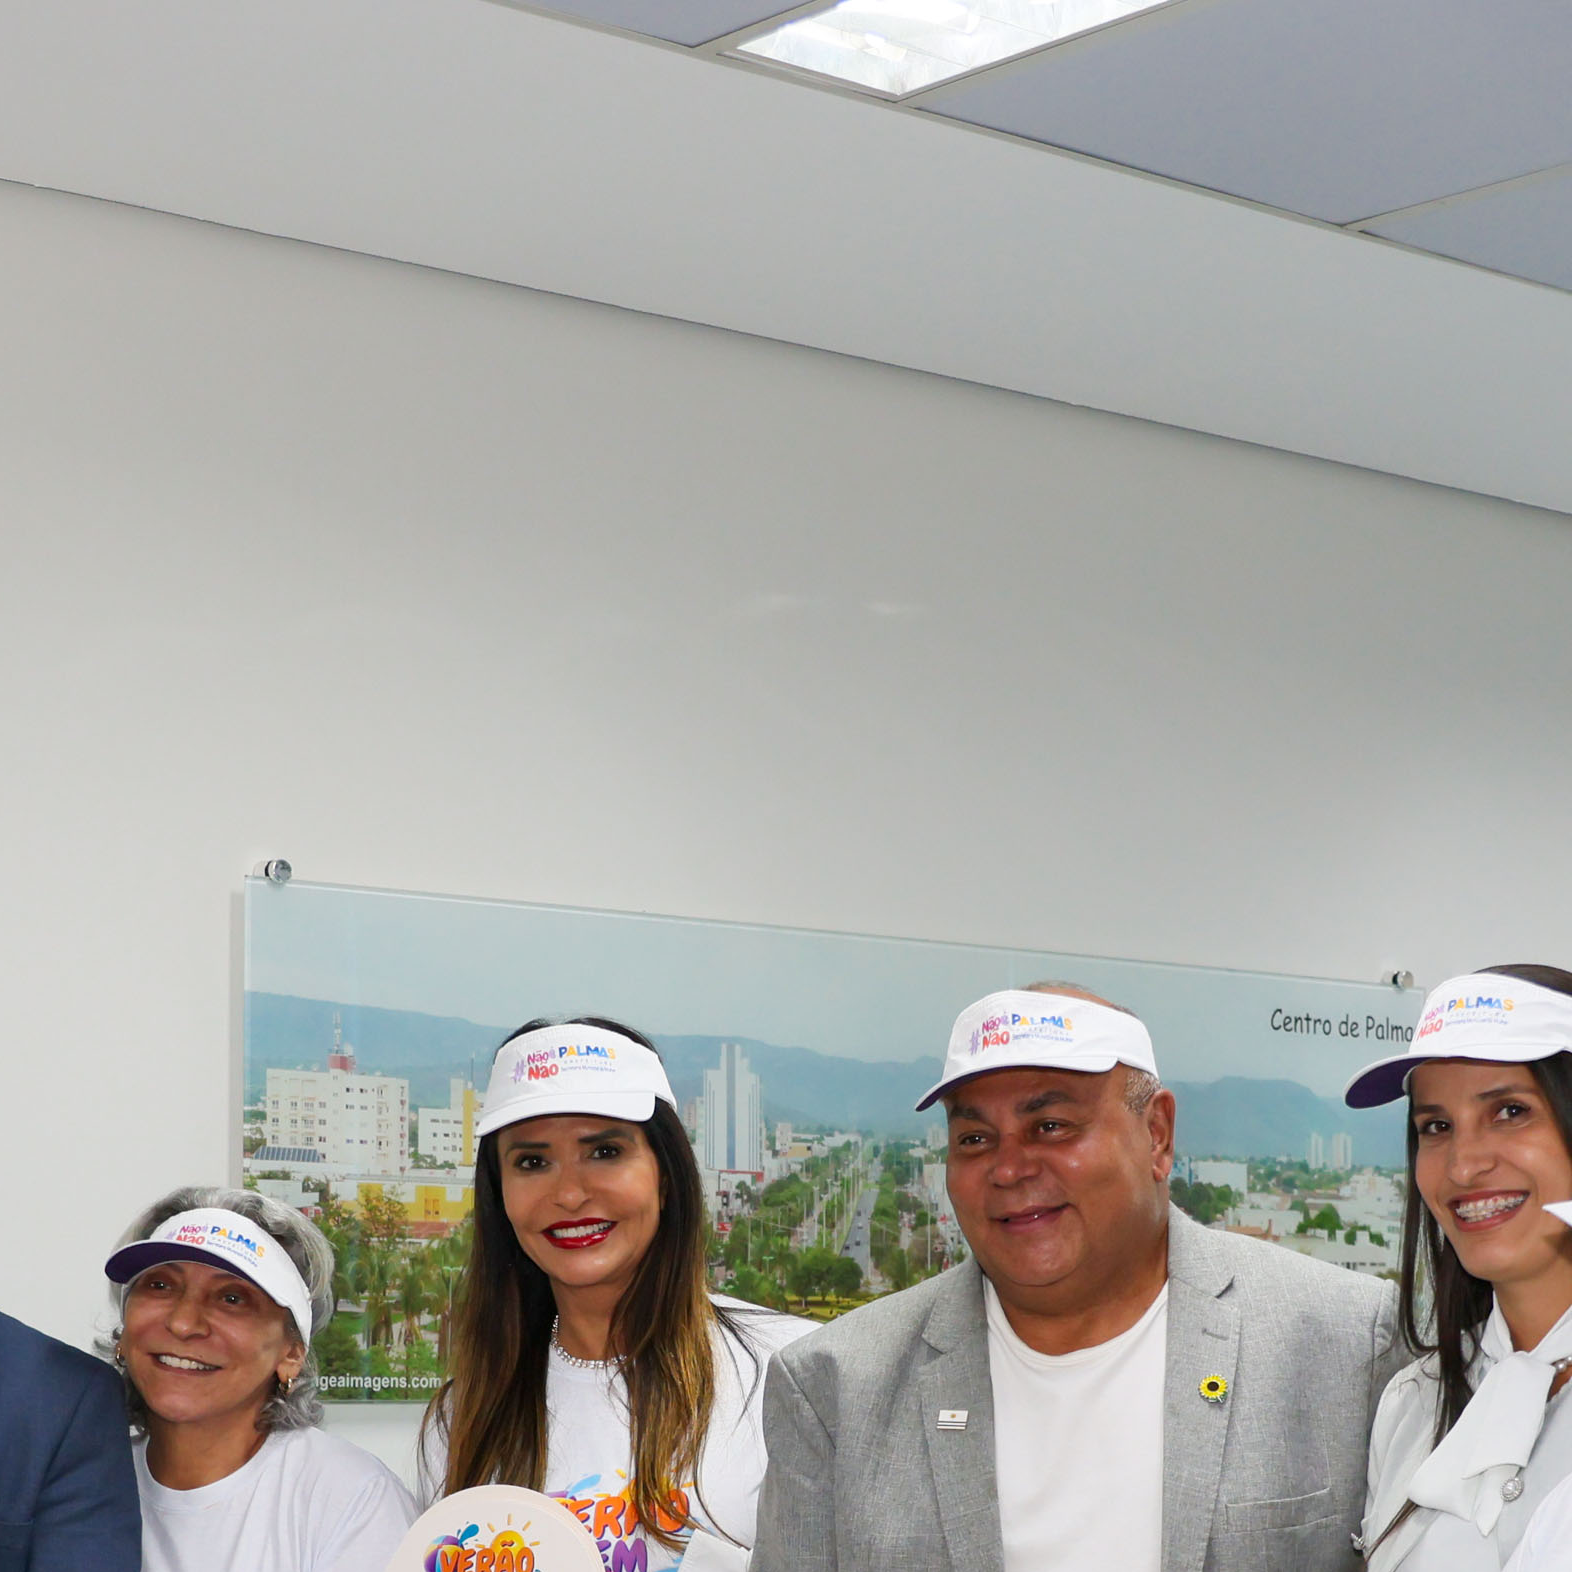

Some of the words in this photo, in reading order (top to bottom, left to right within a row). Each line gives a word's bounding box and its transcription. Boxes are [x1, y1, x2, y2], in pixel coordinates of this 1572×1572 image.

[1448, 996, 1515, 1012] PALMAS
[1012, 1013, 1073, 1031] PALMAS
[1270, 1008, 1332, 1036] Centro
[1338, 1014, 1360, 1038] de
[1366, 1016, 1414, 1043] Palma
[558, 1044, 616, 1059] PALMAS
[210, 1226, 266, 1258] PALMAS
[315, 1373, 442, 1392] geaimagens.com
